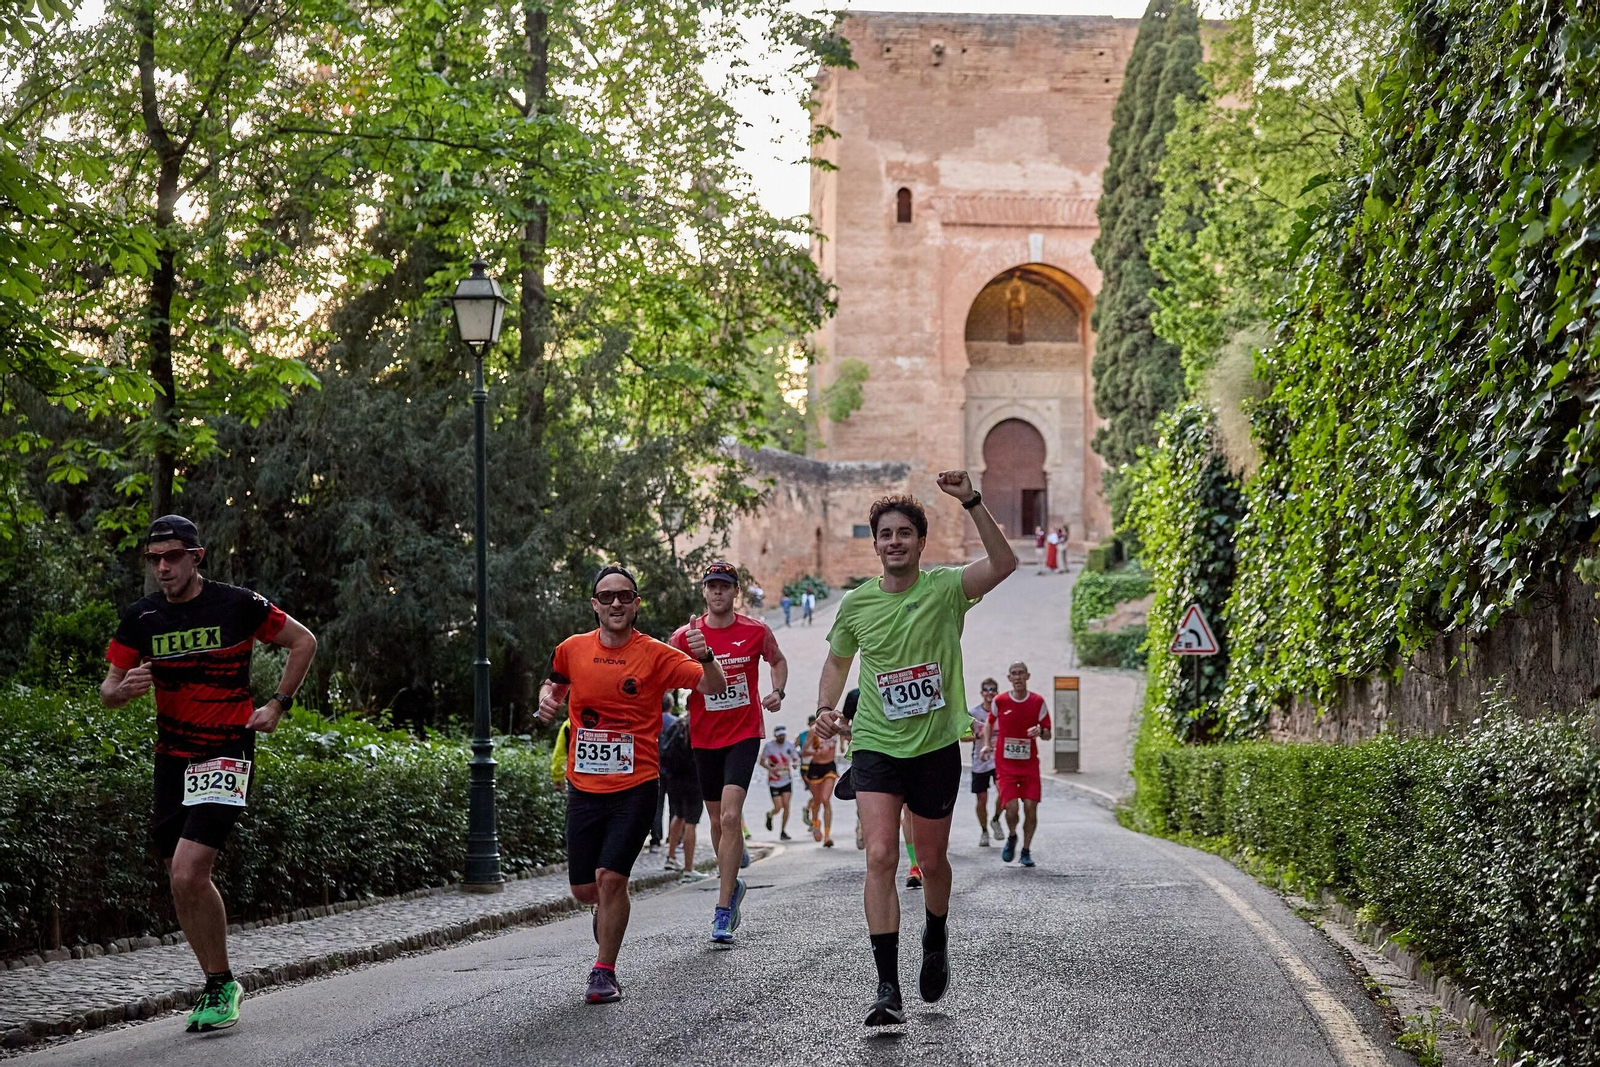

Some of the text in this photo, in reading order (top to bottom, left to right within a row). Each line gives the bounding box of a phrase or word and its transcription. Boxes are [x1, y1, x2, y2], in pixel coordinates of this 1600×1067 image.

[154, 629, 219, 653] TELEX
[593, 657, 626, 666] GIVOVA
[882, 678, 934, 705] 1306
[577, 742, 621, 761] 5351
[1005, 744, 1026, 754] 4387
[187, 772, 236, 794] 3329
